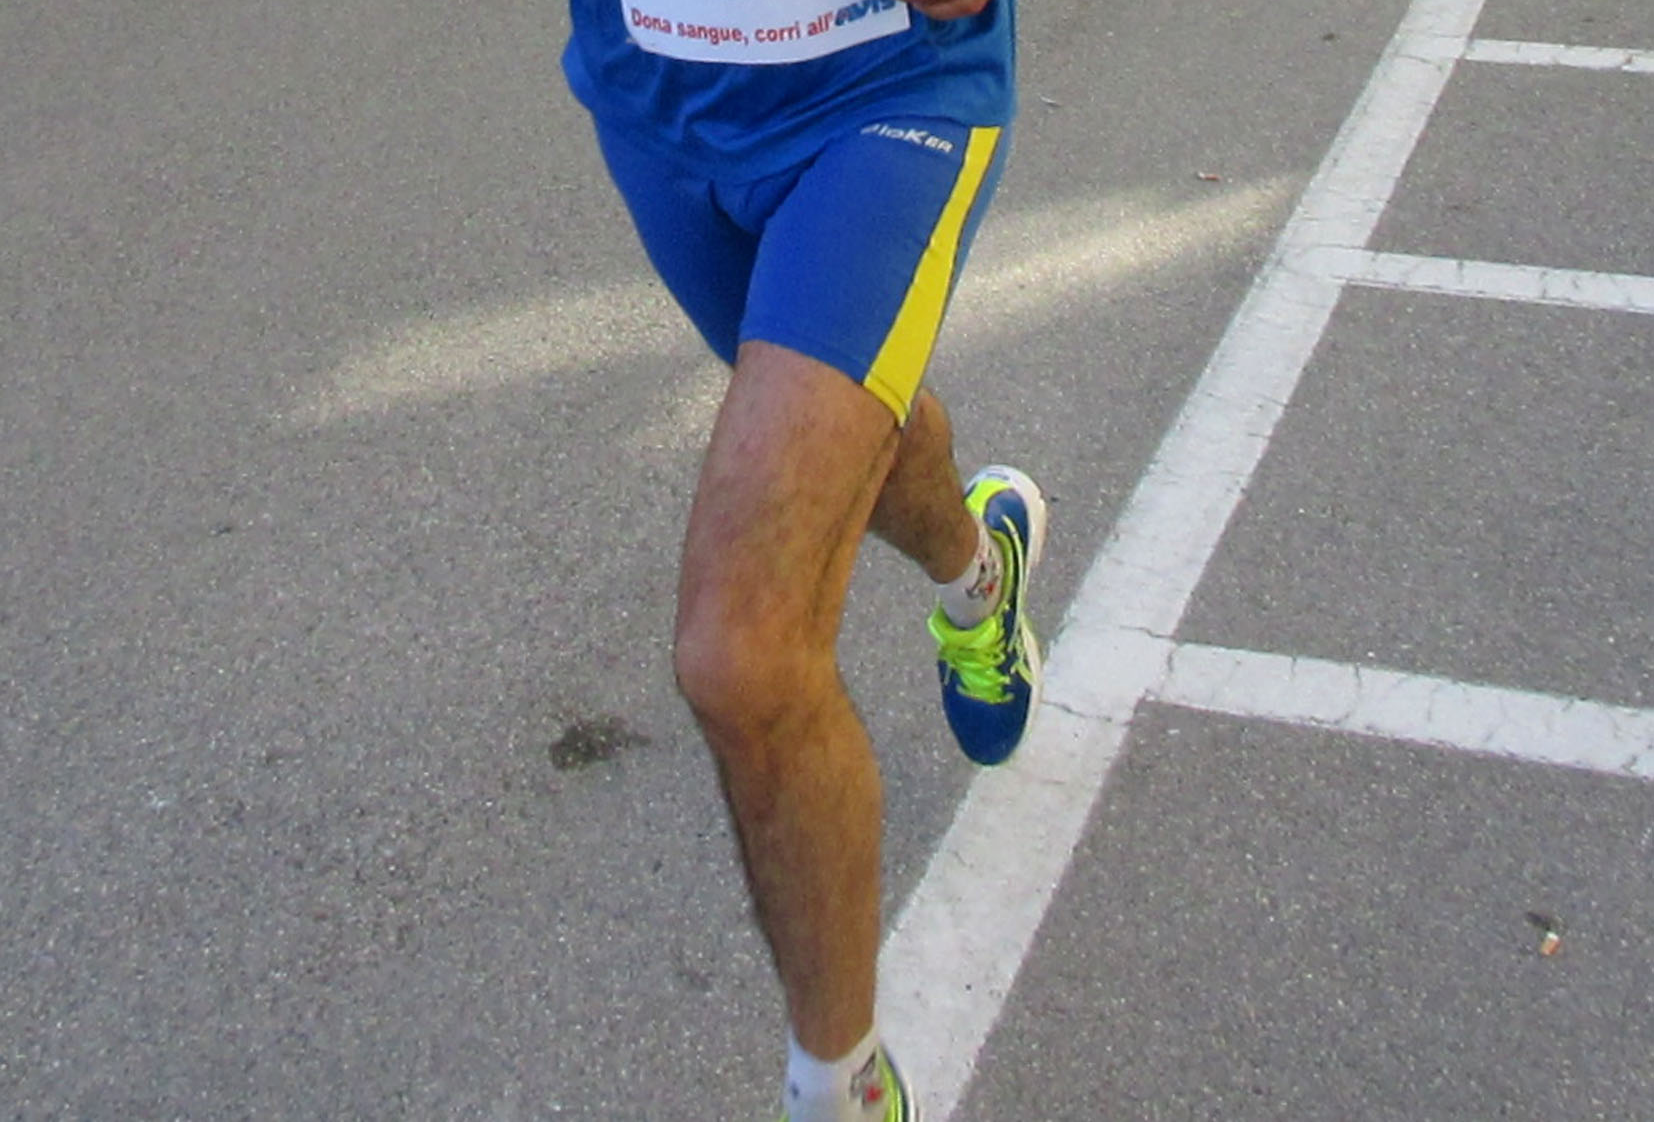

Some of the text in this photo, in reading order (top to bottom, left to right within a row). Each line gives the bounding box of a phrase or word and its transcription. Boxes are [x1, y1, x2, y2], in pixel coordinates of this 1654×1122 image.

[630, 7, 672, 33] Dona
[677, 21, 749, 46] sangue,
[754, 22, 800, 44] corri
